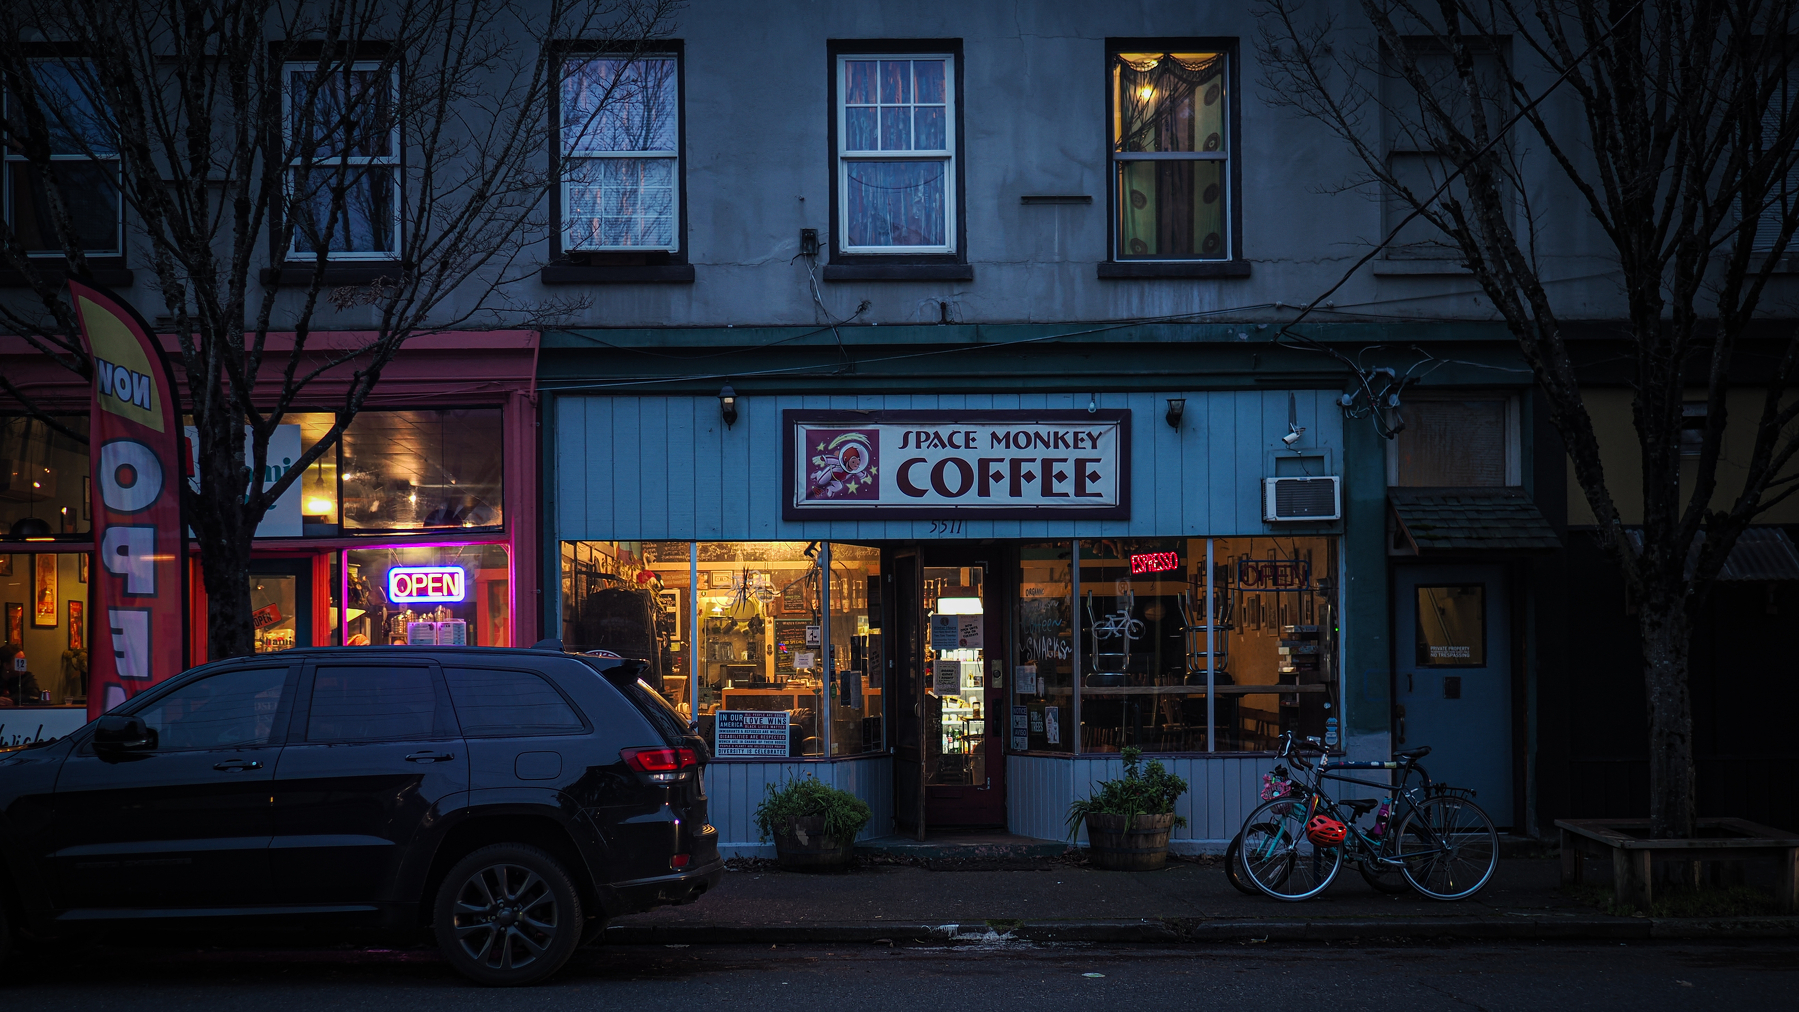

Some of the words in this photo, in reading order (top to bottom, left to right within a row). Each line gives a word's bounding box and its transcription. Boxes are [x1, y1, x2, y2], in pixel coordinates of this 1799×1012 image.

[898, 430, 978, 450] SPACE
[990, 430, 1103, 450] MONKEY
[896, 457, 1104, 498] COFFEE
[1130, 551, 1179, 575] ESPRESSO
[393, 572, 460, 597] OPEN
[1241, 565, 1307, 587] OPEN
[1025, 587, 1045, 597] ORGANIC
[1026, 635, 1067, 661] SNACKS
[16, 659, 25, 668] 12
